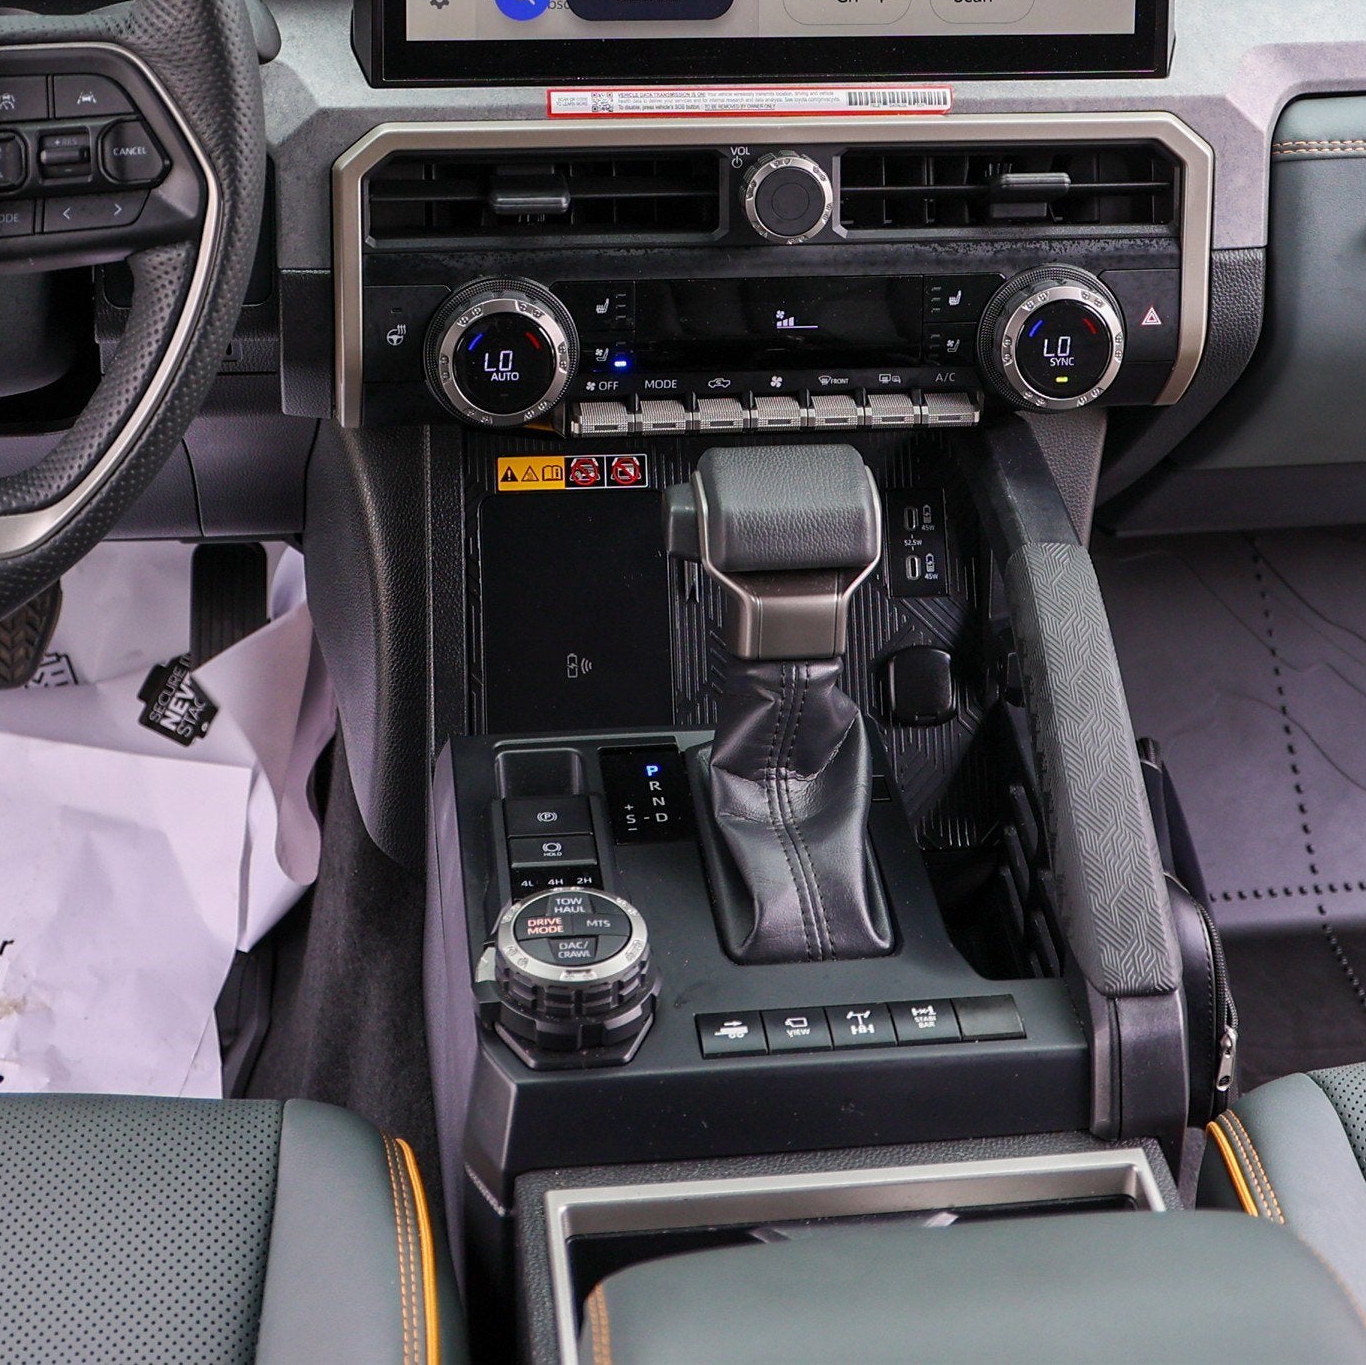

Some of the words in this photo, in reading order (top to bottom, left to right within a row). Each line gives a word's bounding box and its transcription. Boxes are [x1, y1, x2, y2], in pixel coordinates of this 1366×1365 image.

[112, 146, 147, 156] CANCEL
[730, 146, 751, 156] VOL
[1043, 336, 1071, 357] LO
[484, 350, 513, 371] LO
[1050, 357, 1075, 367] SYNC
[490, 371, 519, 382] AUTO
[830, 377, 849, 385] FRONT
[935, 372, 956, 383] A/C
[598, 381, 620, 391] OFF
[644, 379, 678, 389] MODE
[149, 666, 186, 723] SECURE
[646, 765, 659, 777] P
[649, 780, 662, 791] R
[652, 796, 666, 806] N
[656, 812, 668, 823] D
[520, 879, 534, 887] 4L
[547, 877, 564, 886] 4H
[576, 876, 593, 885] 2H
[555, 897, 582, 906] TOW
[554, 905, 586, 914] HAUL
[527, 917, 563, 927] DRIVE
[586, 919, 611, 928] MTS
[527, 925, 564, 935] MODE
[559, 941, 588, 951] DAC/
[558, 949, 591, 959] CRAWL
[918, 1021, 936, 1029] BAR
[786, 1027, 812, 1037] VIEW
